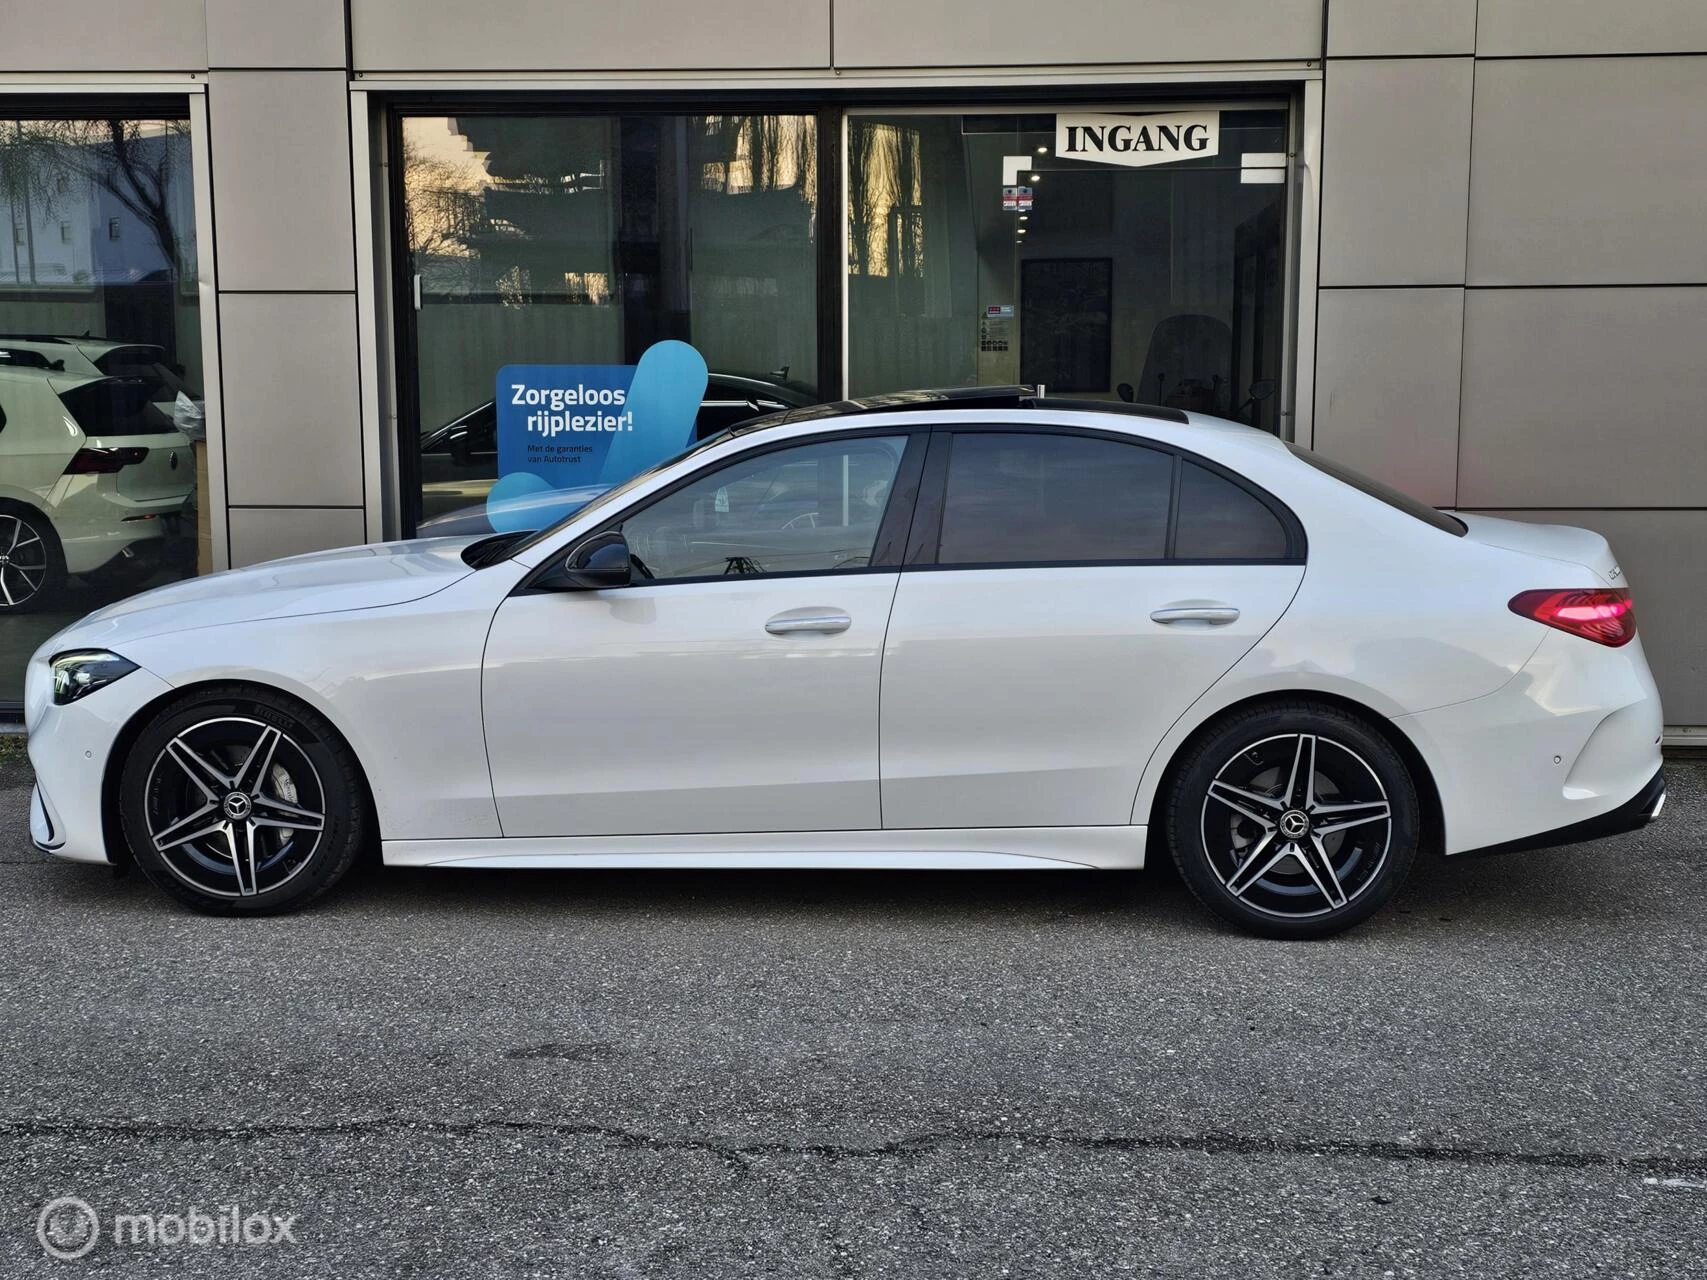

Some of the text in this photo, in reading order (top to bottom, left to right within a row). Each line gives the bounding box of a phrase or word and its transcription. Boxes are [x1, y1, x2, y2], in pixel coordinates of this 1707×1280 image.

[1065, 124, 1210, 153] INGANG
[511, 384, 626, 411] Zorgeloos
[527, 410, 633, 437] rijplezier!
[527, 445, 593, 455] Met de garanties
[527, 455, 581, 463] van Autotrust
